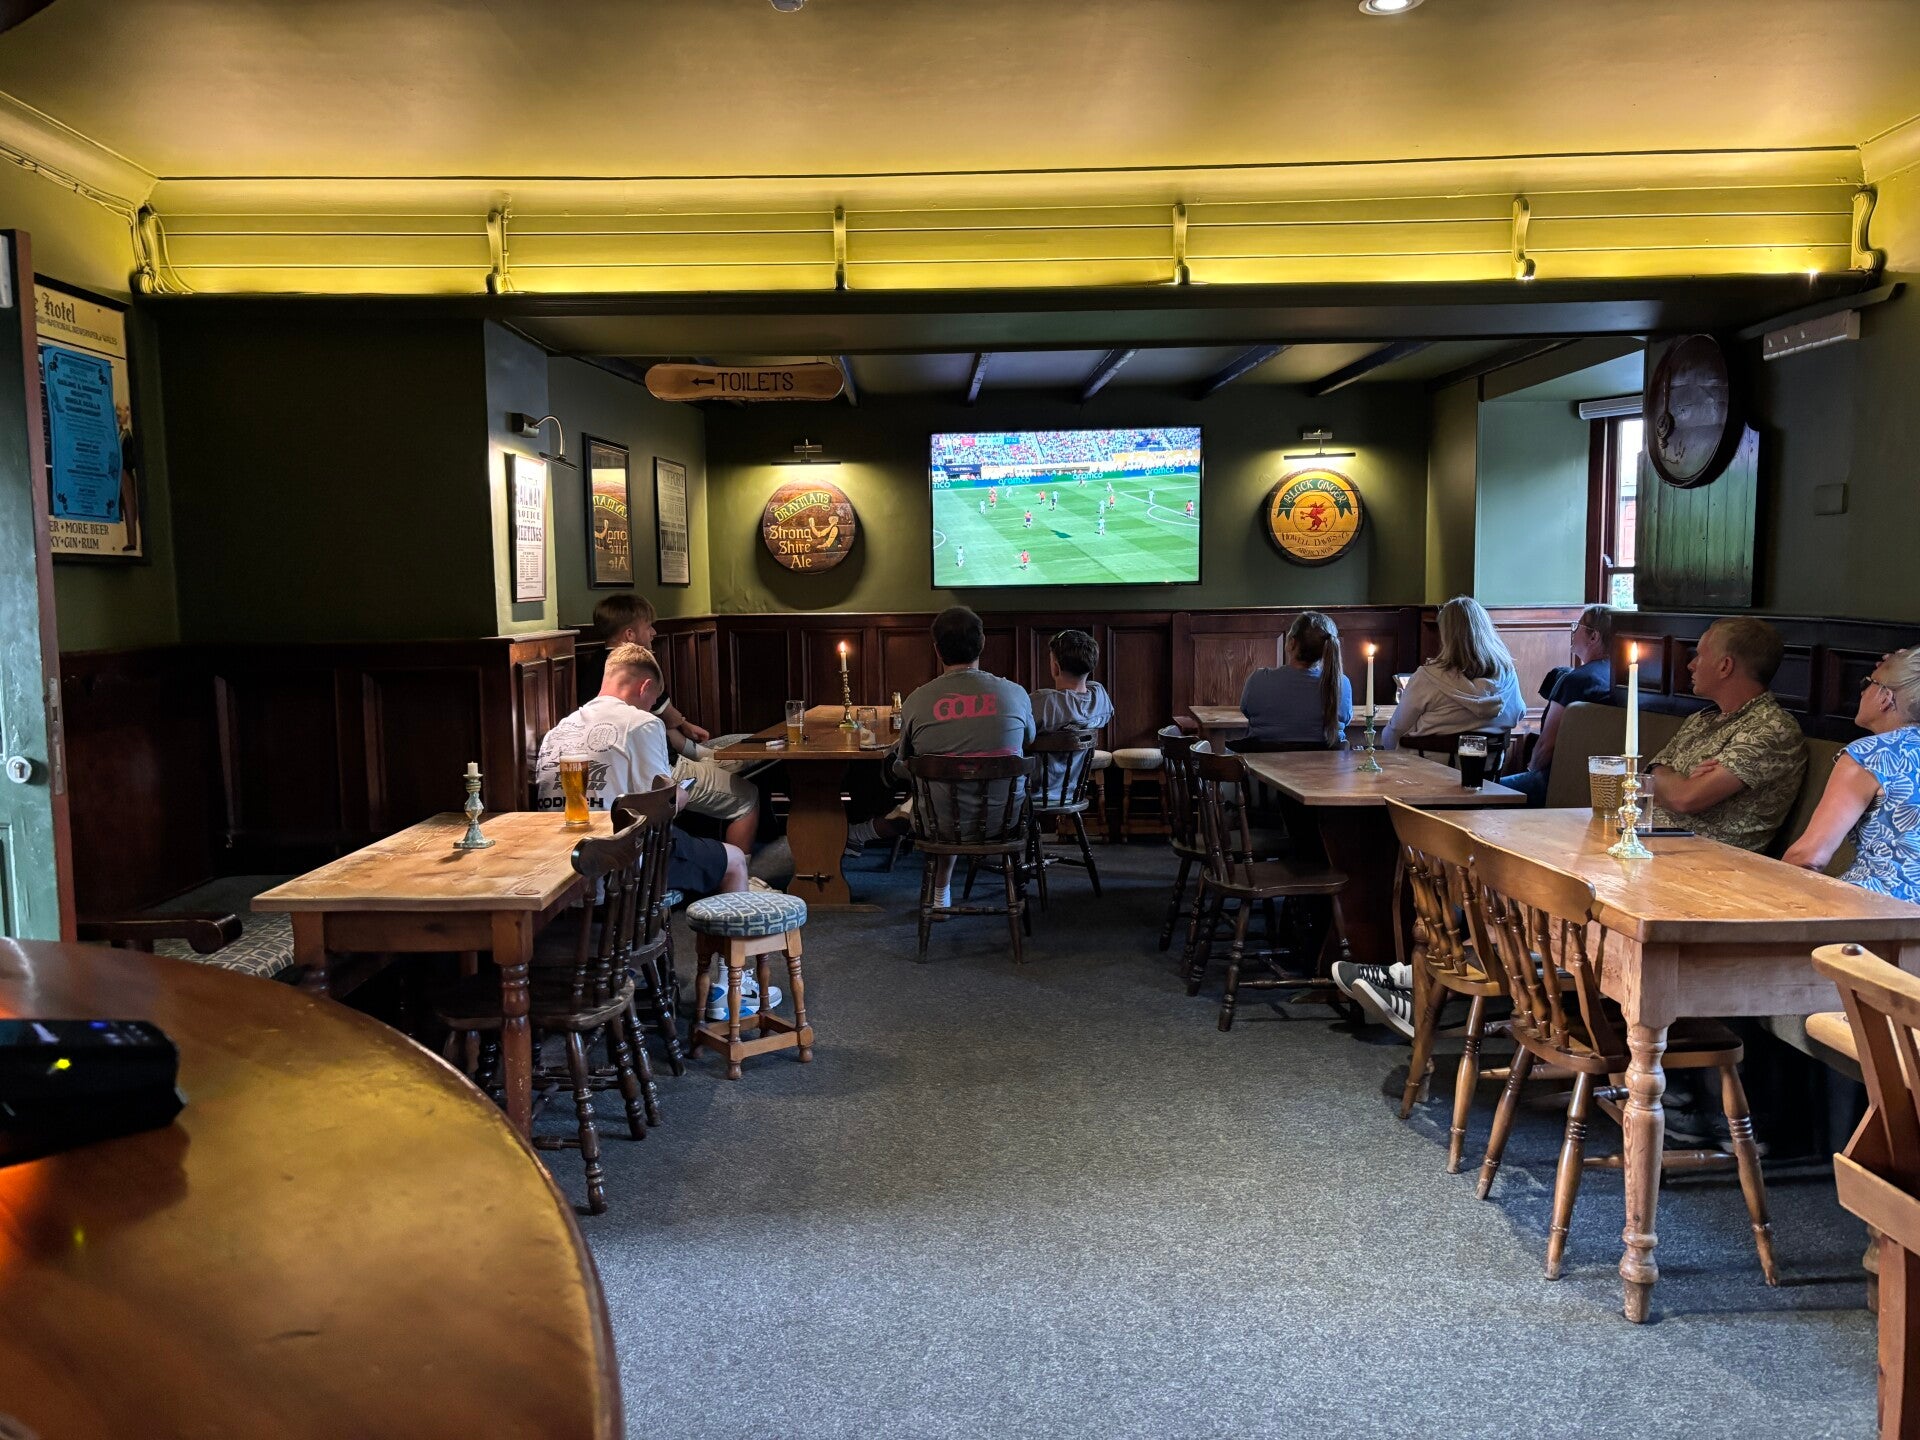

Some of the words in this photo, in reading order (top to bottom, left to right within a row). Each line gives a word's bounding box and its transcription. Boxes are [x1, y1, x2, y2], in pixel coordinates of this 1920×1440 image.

[717, 371, 794, 391] TOILETS
[1072, 472, 1104, 480] aramco
[1144, 467, 1176, 476] aramco
[998, 477, 1031, 487] aramco
[1283, 479, 1314, 504] BLACK
[1317, 479, 1347, 504] GINGER
[65, 522, 89, 535] MORE
[90, 523, 110, 535] BEER
[769, 525, 813, 542] Strong
[64, 536, 78, 549] GIN
[81, 537, 100, 550] RUM
[779, 540, 812, 555] Shire
[790, 554, 813, 569] Ale
